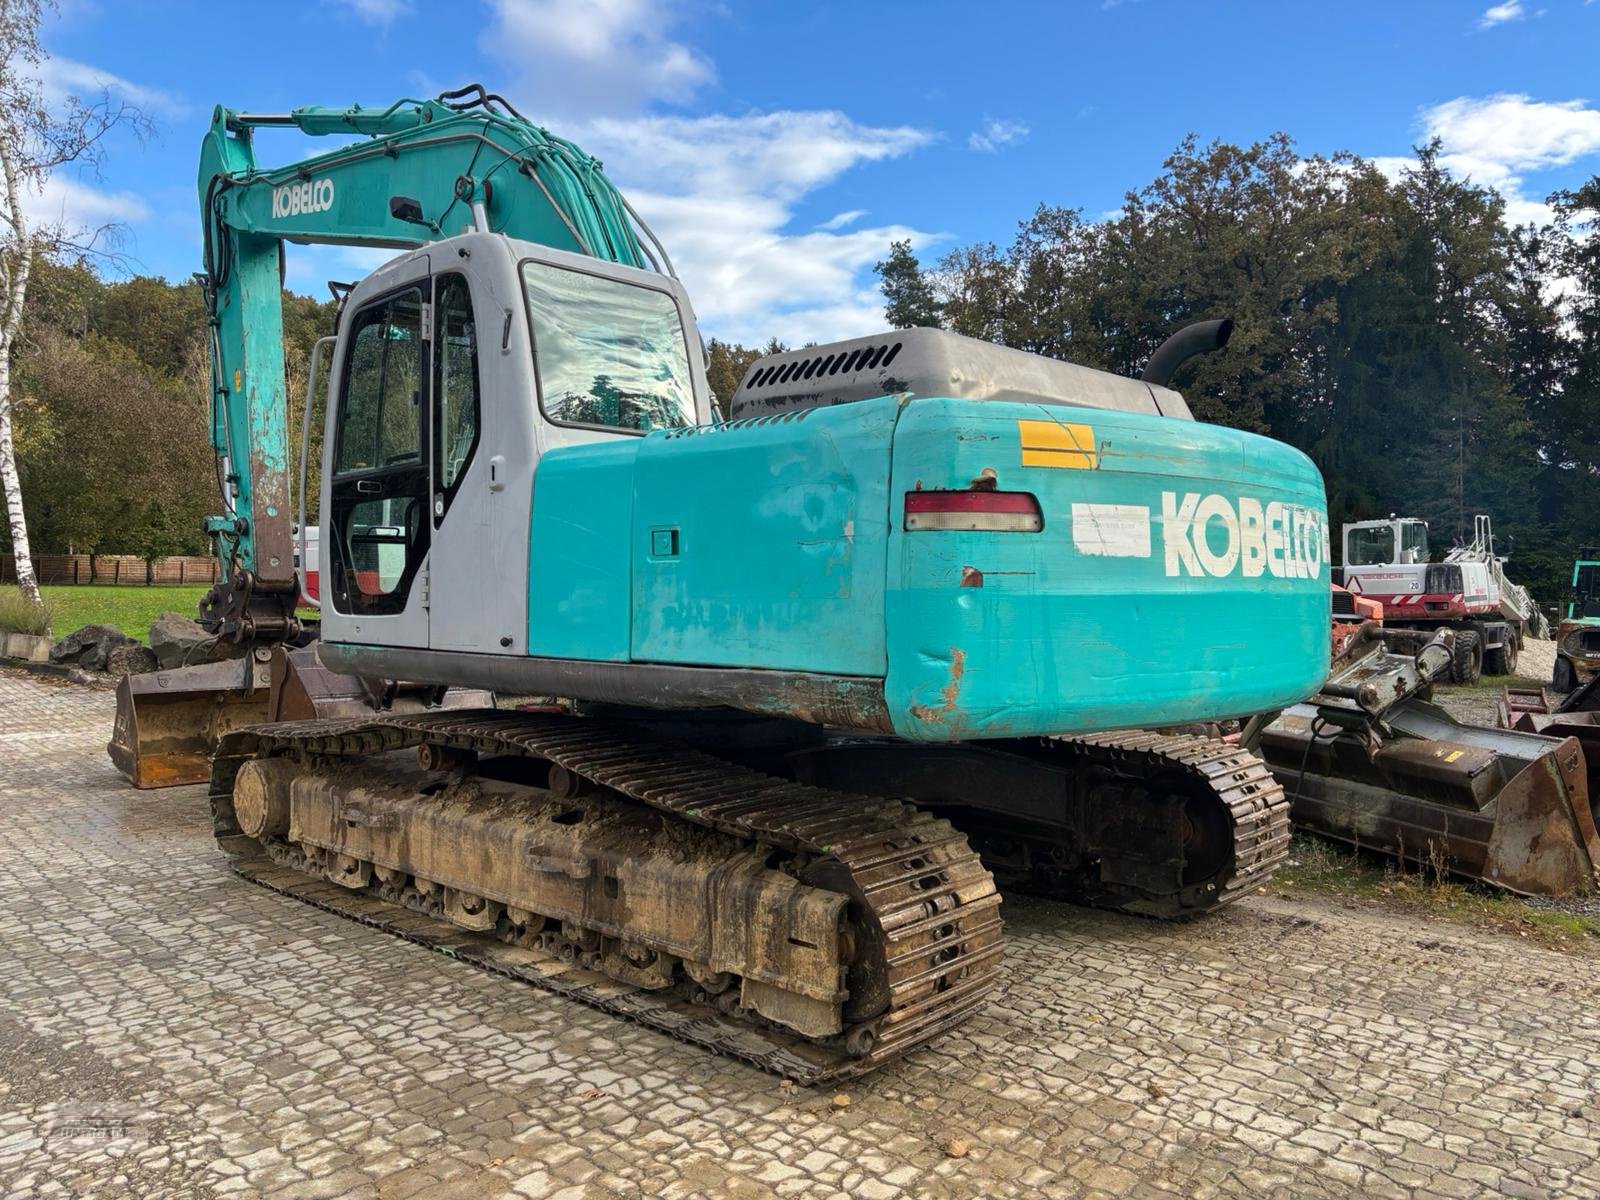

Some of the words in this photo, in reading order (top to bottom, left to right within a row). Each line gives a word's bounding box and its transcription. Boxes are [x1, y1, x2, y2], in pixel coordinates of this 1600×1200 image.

[272, 179, 334, 218] KOBELCO
[1162, 491, 1320, 579] KOBELCO
[1411, 582, 1419, 590] 20
